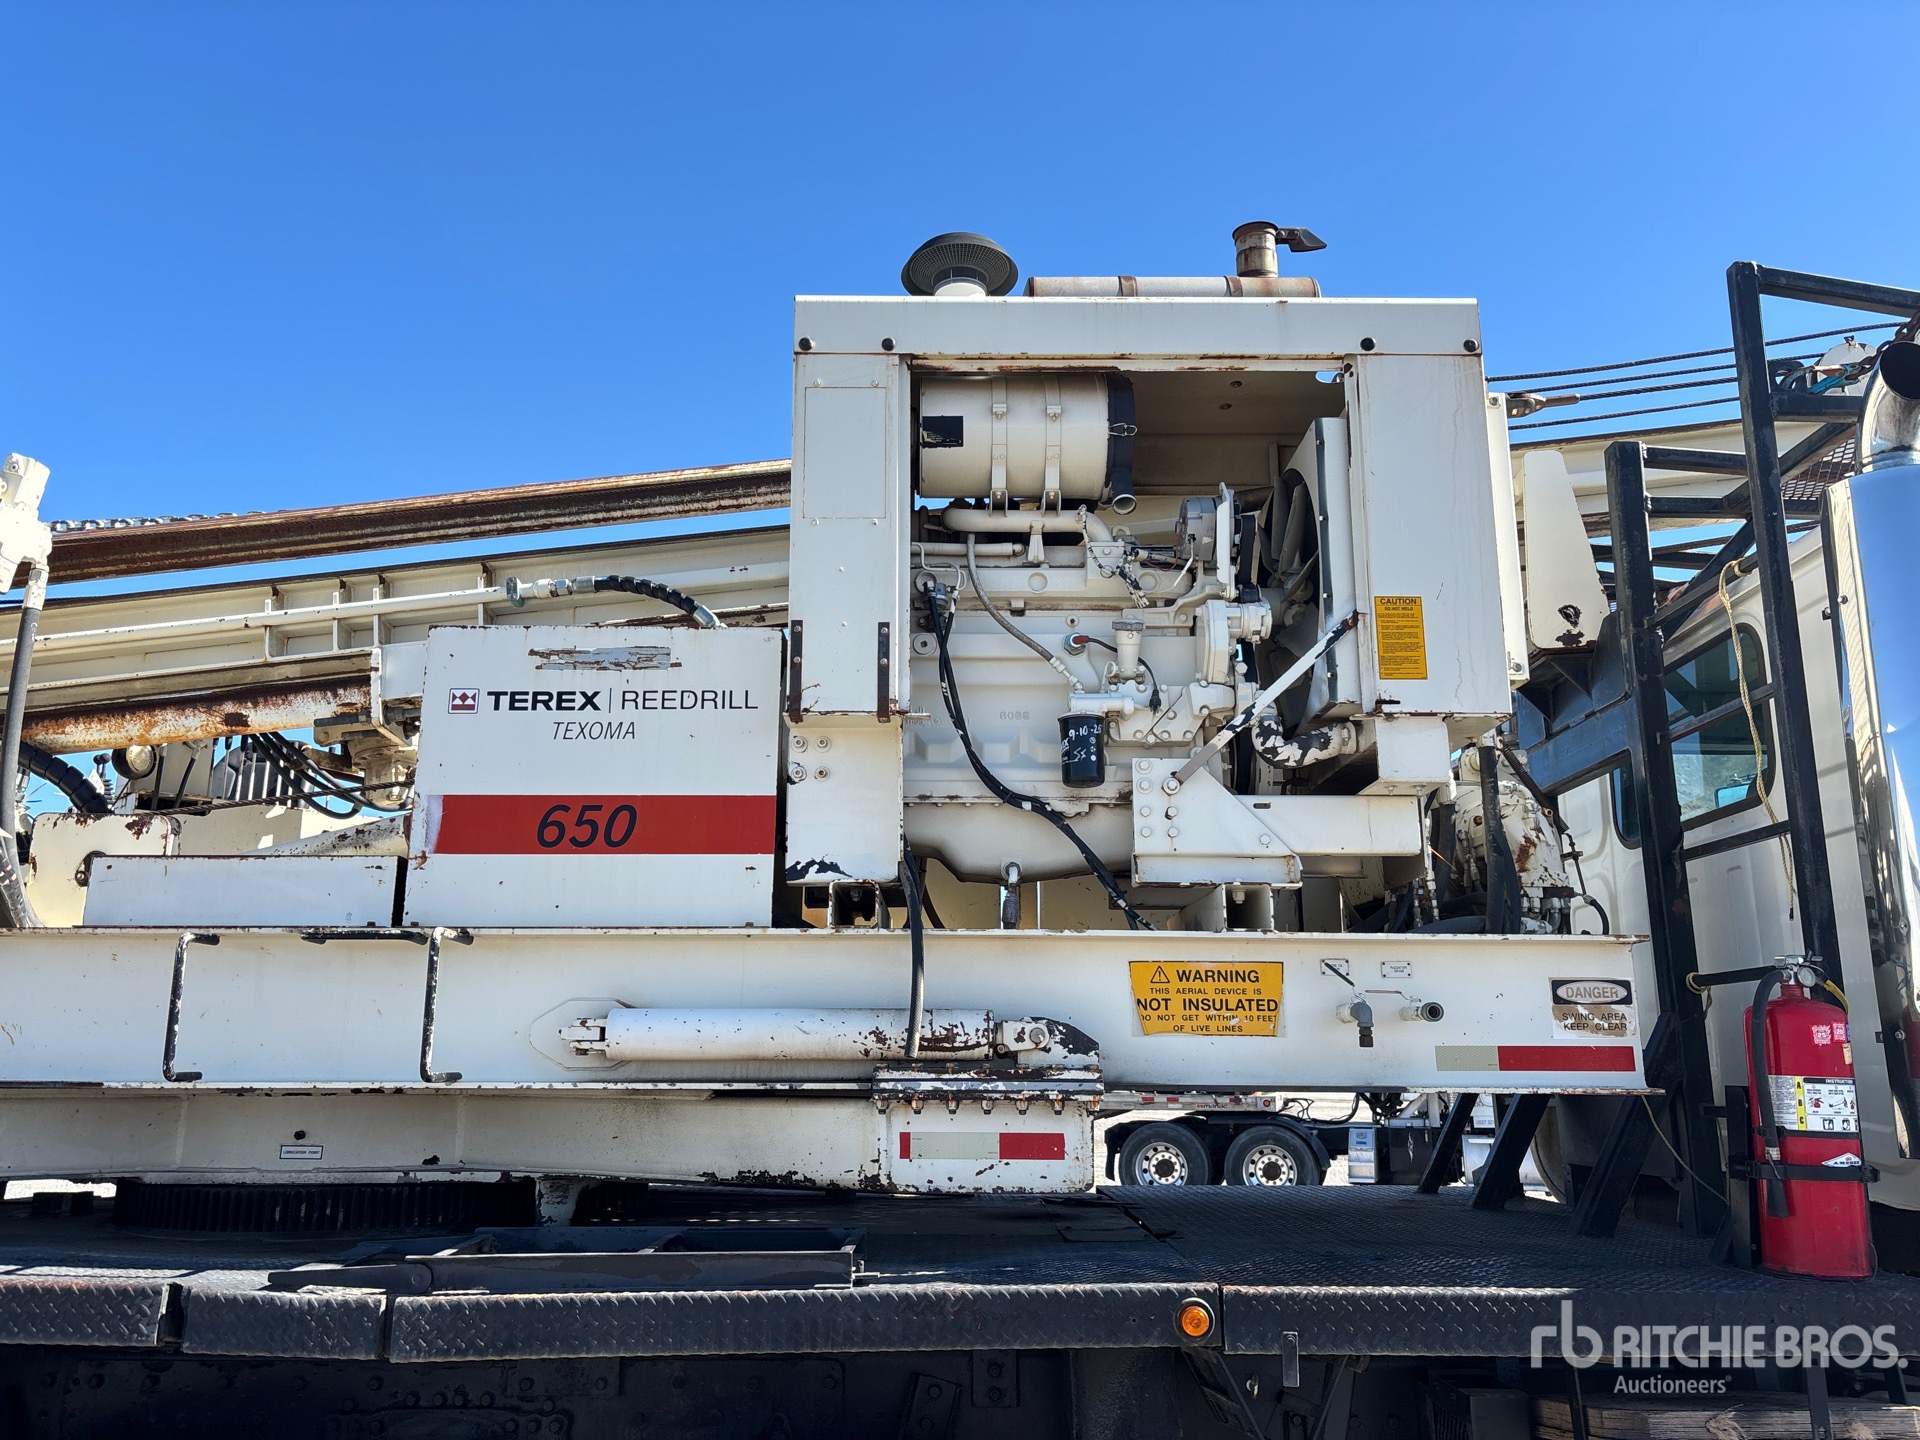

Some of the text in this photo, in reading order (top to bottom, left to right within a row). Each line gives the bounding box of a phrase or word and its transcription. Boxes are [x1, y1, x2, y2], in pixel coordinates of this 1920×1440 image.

[487, 690, 759, 712] TEREX REEDRILL
[552, 721, 636, 741] TEXOMA
[536, 804, 638, 849] 650
[1176, 969, 1260, 983] WARNING
[1150, 987, 1170, 995] THIS
[1175, 987, 1208, 995] AERIAL
[1565, 986, 1619, 999] DANGER
[1137, 998, 1278, 1012] NOT INSULATED
[1157, 1014, 1176, 1022] NOT
[1205, 1014, 1238, 1022] WITHIN
[1562, 1012, 1627, 1021] SWING AREA
[1173, 1024, 1185, 1032] OF
[1563, 1022, 1628, 1031] KEEP CLEAR
[1797, 1081, 1802, 1090] A
[1797, 1098, 1803, 1107] B
[1799, 1116, 1805, 1125] C
